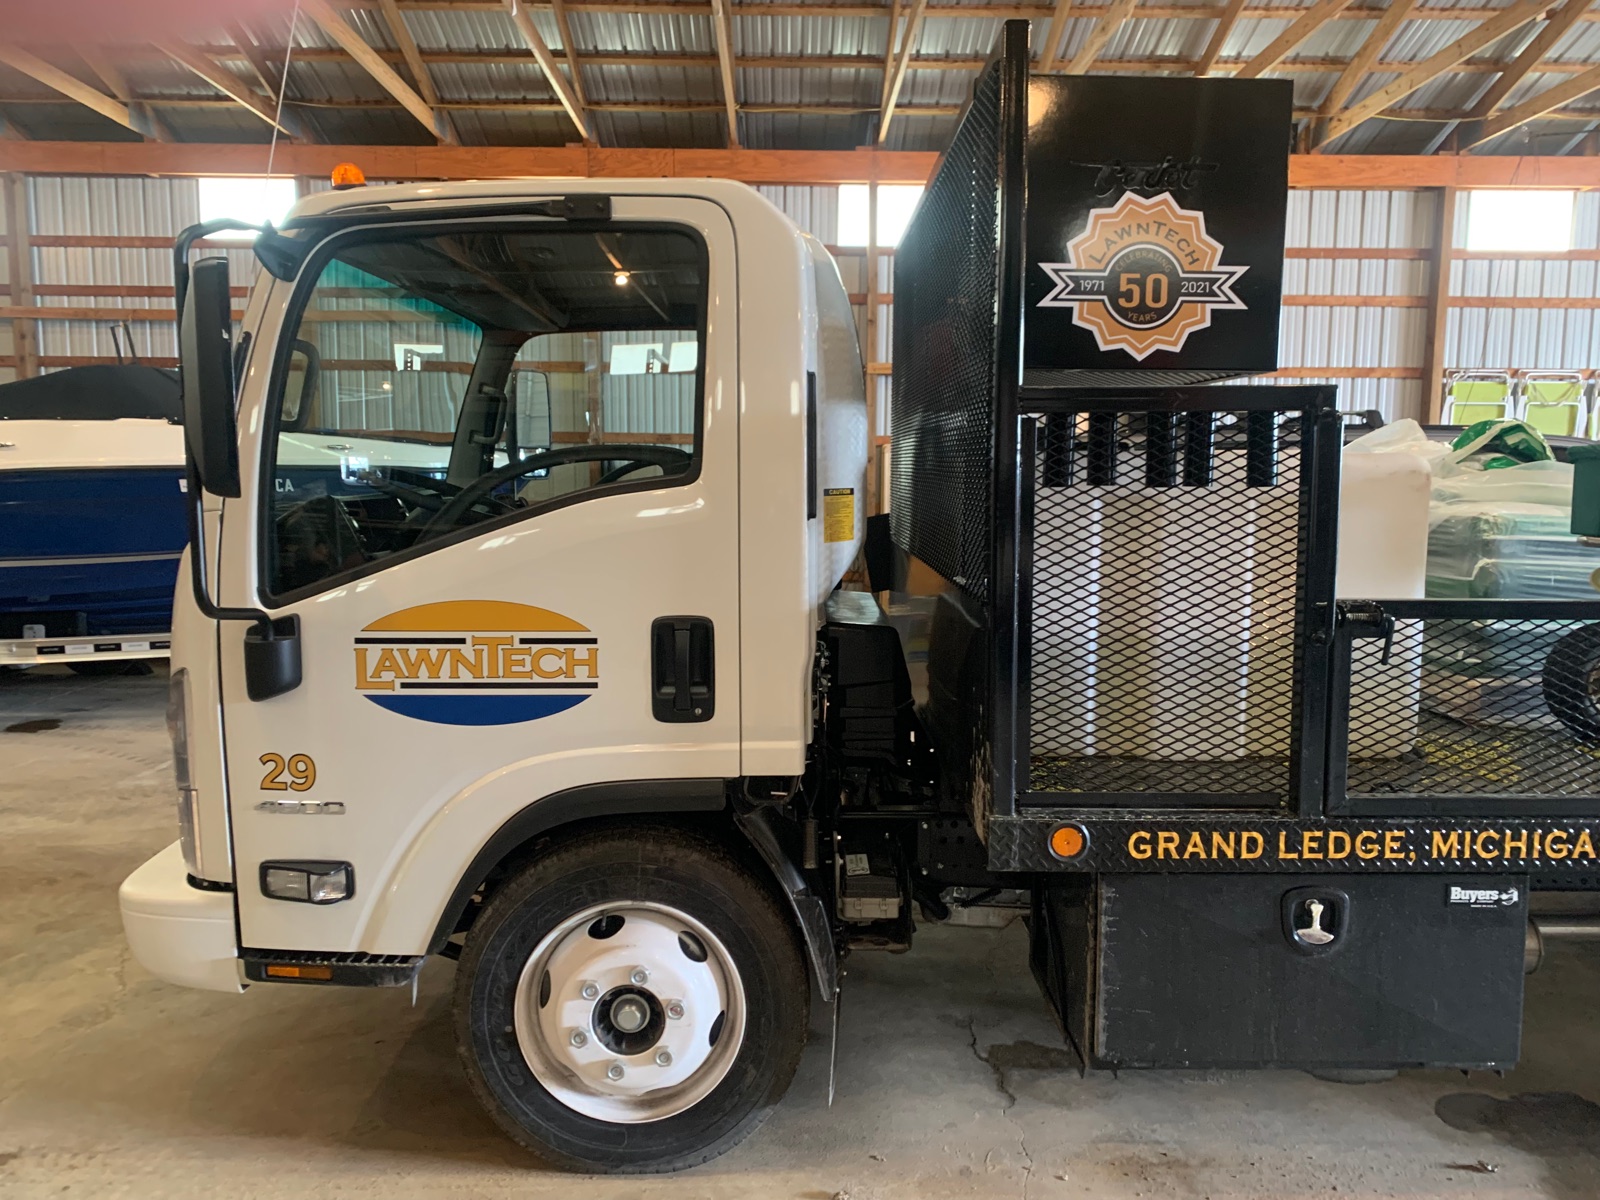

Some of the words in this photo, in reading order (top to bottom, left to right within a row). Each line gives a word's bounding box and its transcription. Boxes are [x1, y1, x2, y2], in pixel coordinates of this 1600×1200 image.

[1115, 250, 1173, 273] CELEBRATING
[1079, 280, 1105, 291] 1971
[1118, 273, 1168, 309] 50
[1181, 281, 1210, 293] 2021
[1127, 311, 1158, 322] YEARS
[353, 635, 599, 691] LAWNTECH
[259, 752, 316, 792] 29
[1128, 831, 1264, 860] GRAND
[1278, 831, 1417, 862] LEDGE,
[1431, 831, 1596, 859] MICHIGA
[1450, 887, 1499, 903] Buyers
